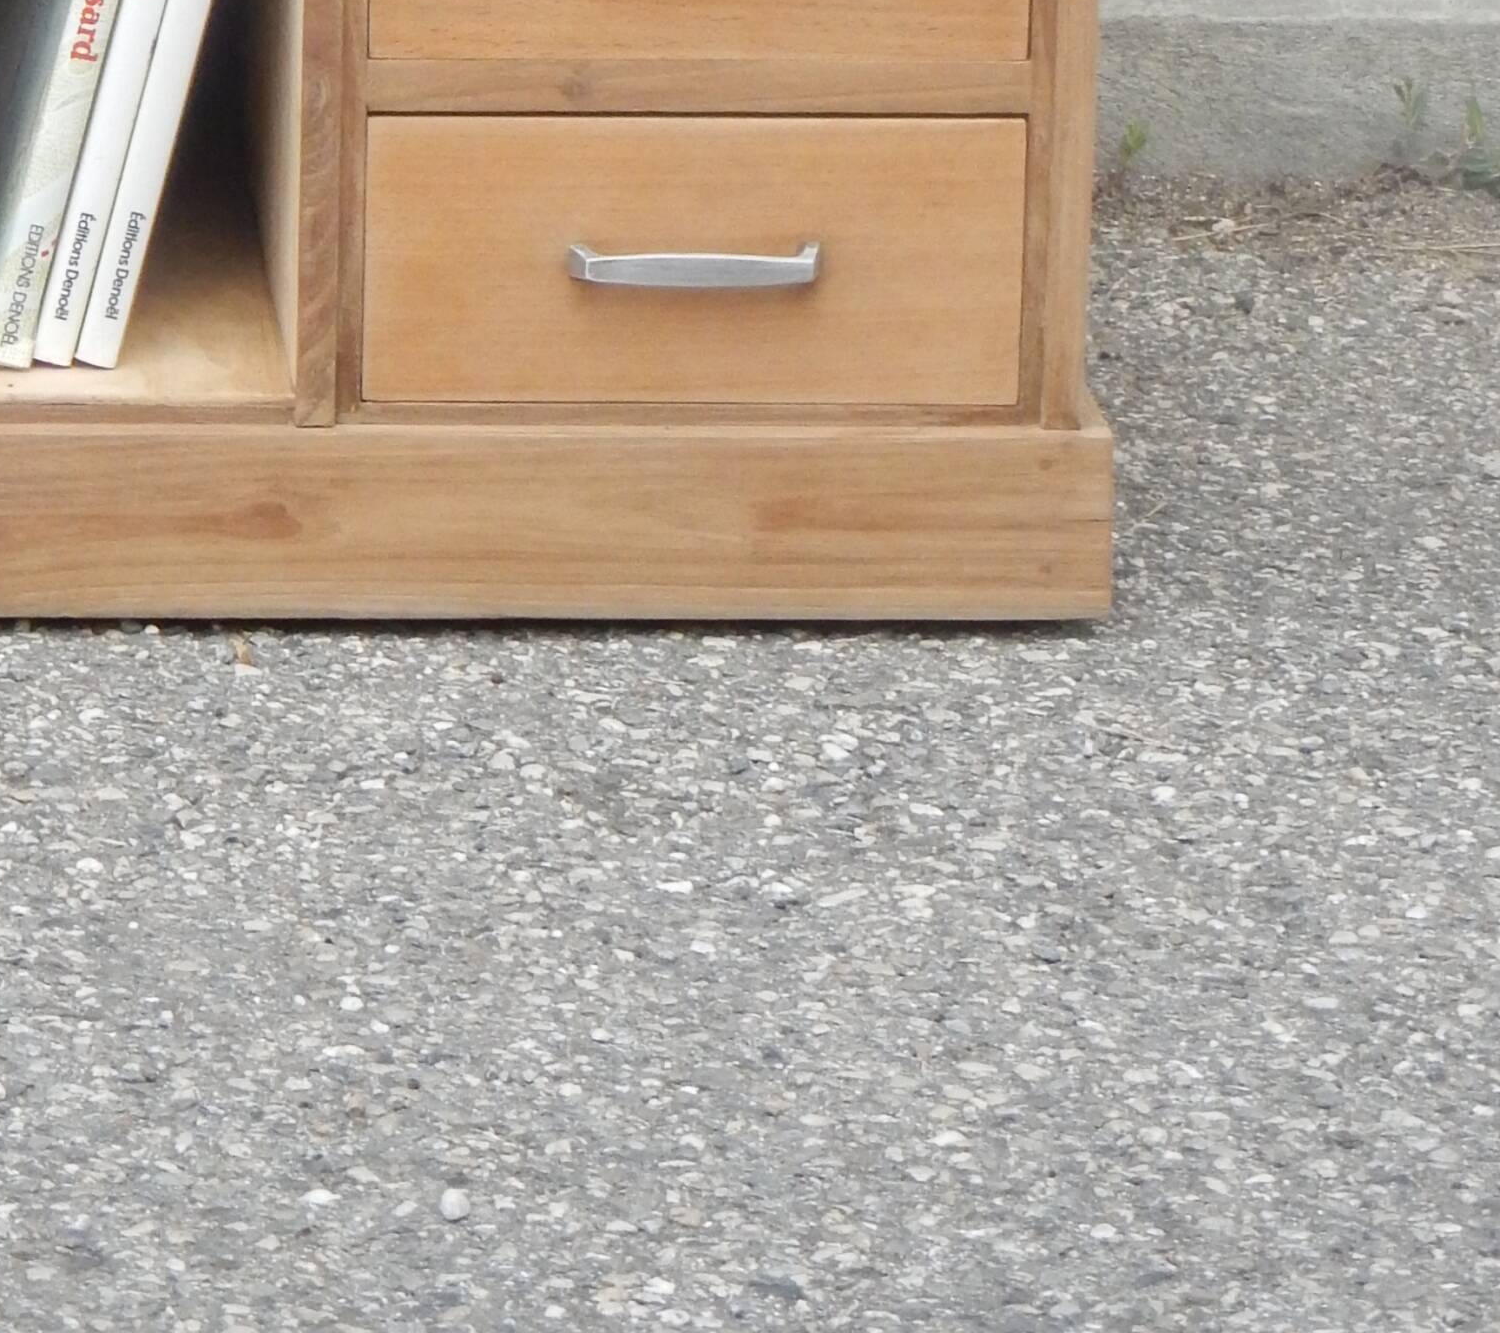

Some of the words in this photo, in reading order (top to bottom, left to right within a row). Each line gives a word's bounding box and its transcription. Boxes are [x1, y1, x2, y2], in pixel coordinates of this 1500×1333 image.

[16, 224, 45, 289] EDITIONS
[68, 212, 97, 267] Éditions
[118, 211, 147, 267] Éditions
[54, 269, 79, 321] Denoël
[105, 269, 129, 321] Denoël
